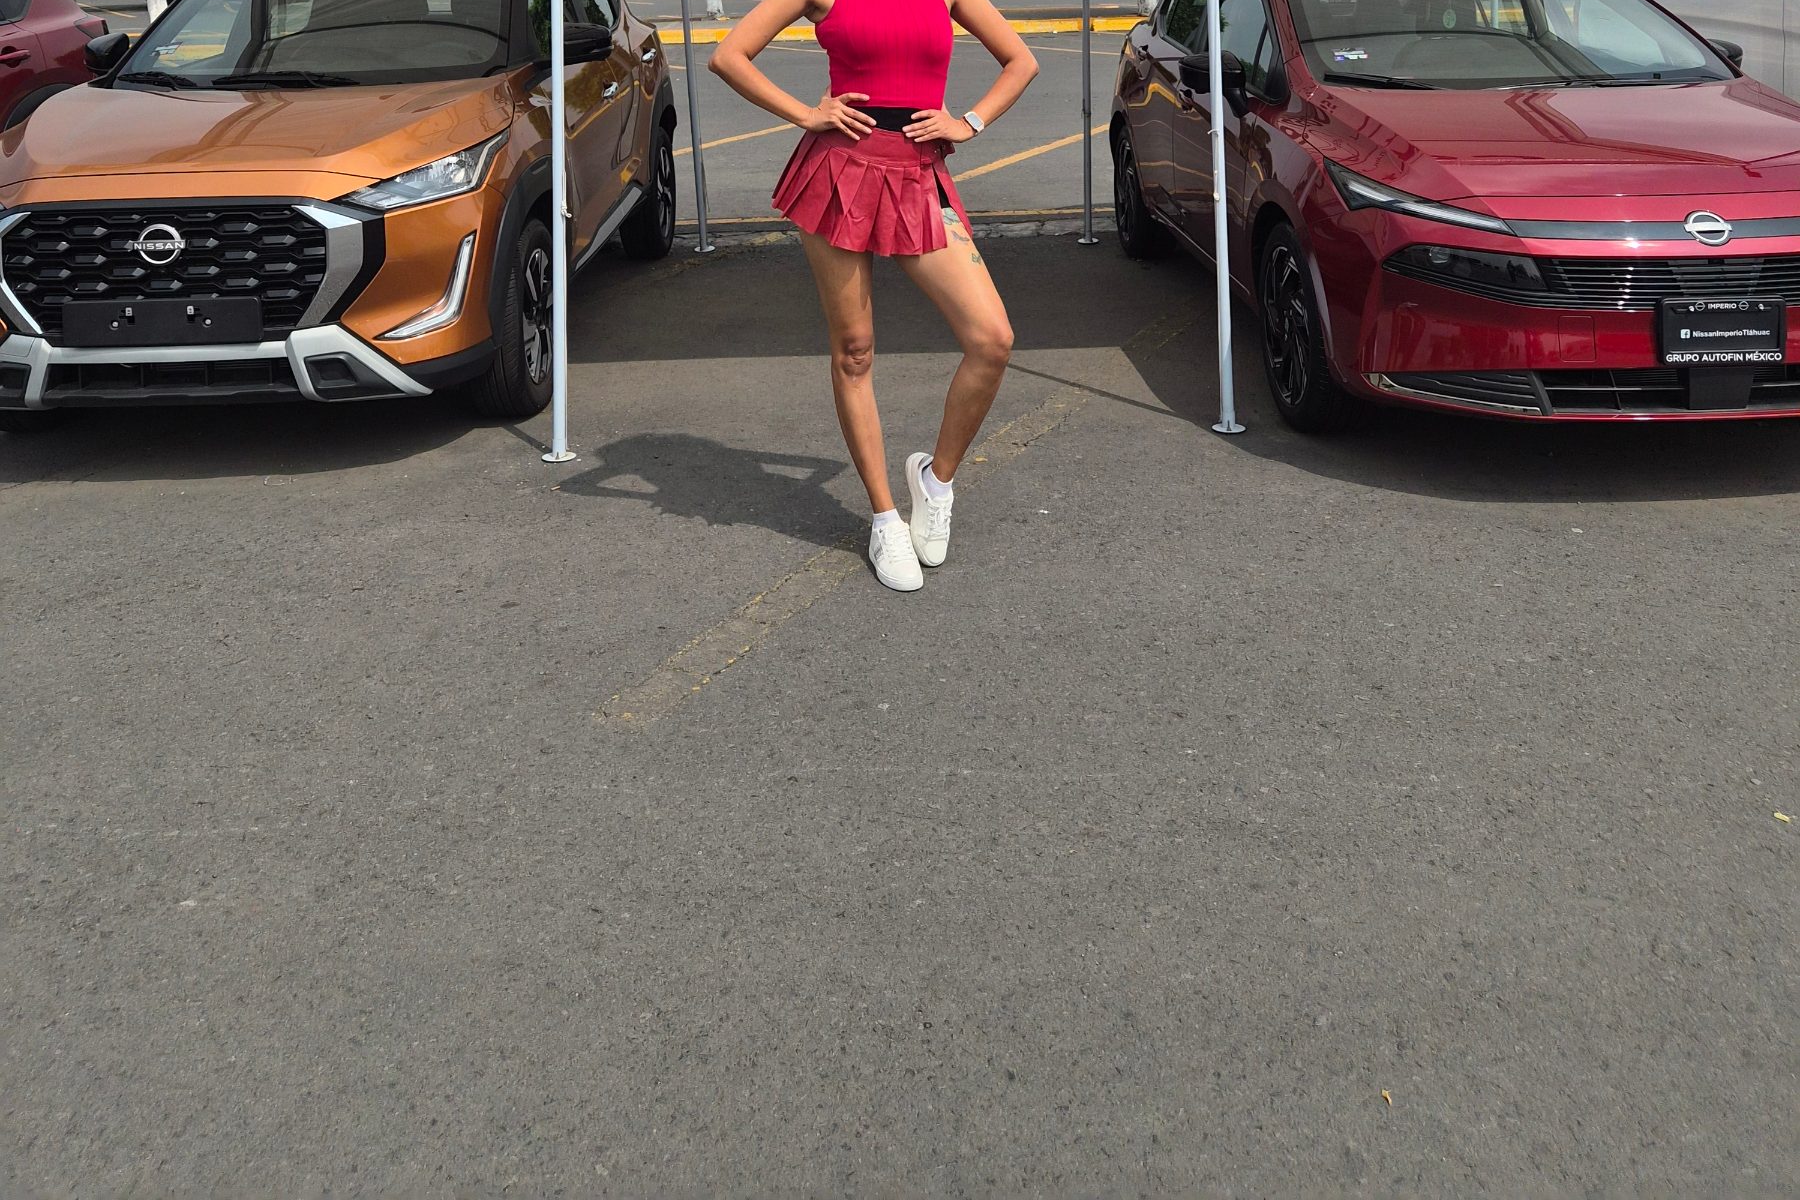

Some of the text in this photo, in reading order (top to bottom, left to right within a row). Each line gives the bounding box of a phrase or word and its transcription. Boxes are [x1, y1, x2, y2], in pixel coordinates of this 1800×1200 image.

[133, 242, 184, 250] NISSAN
[1707, 302, 1737, 310] IMPERIO
[1665, 350, 1783, 362] GRUPO AUTOFIN MÉXICO
